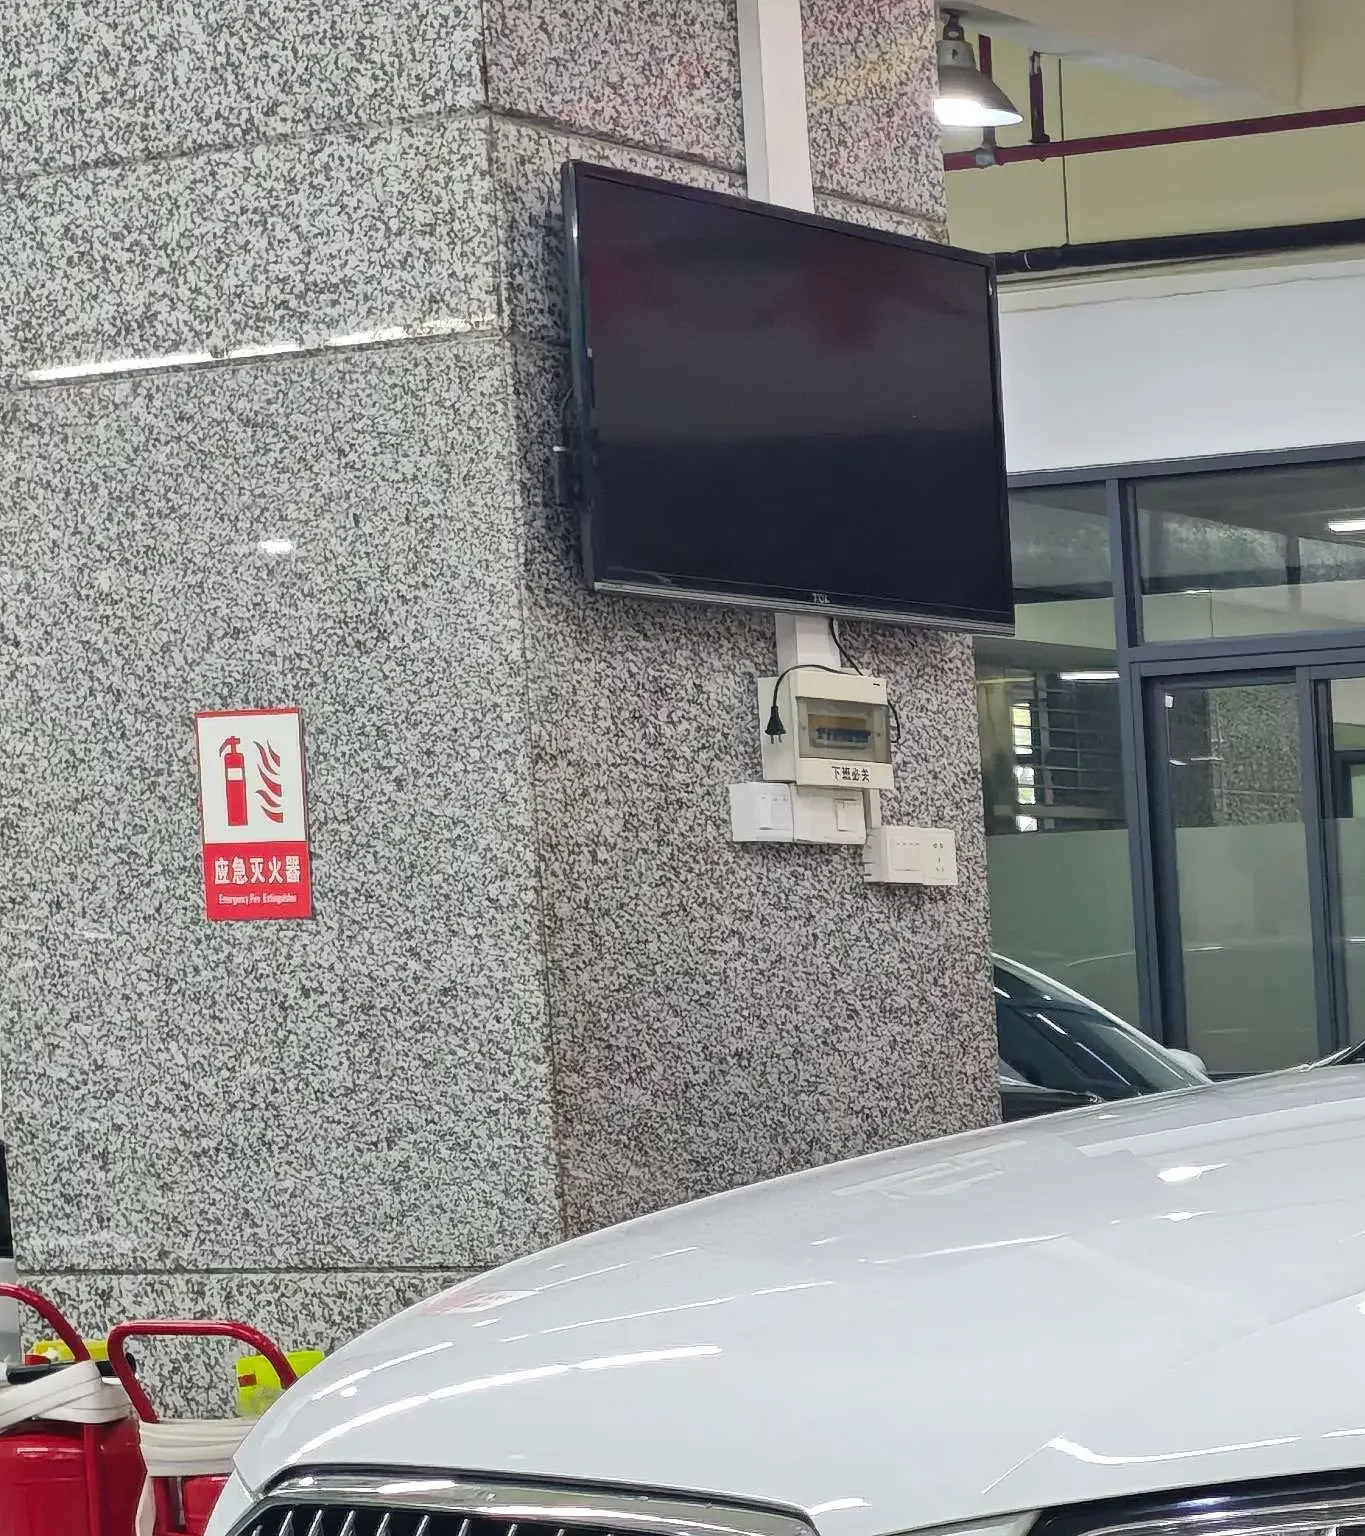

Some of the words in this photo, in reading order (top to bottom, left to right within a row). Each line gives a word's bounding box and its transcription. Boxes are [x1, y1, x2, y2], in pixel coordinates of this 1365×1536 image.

[812, 592, 831, 604] TCL
[214, 855, 300, 884] 应急灭火器
[218, 893, 249, 906] Emergency
[249, 892, 261, 904] Fire
[262, 892, 297, 905] Extinguisher
